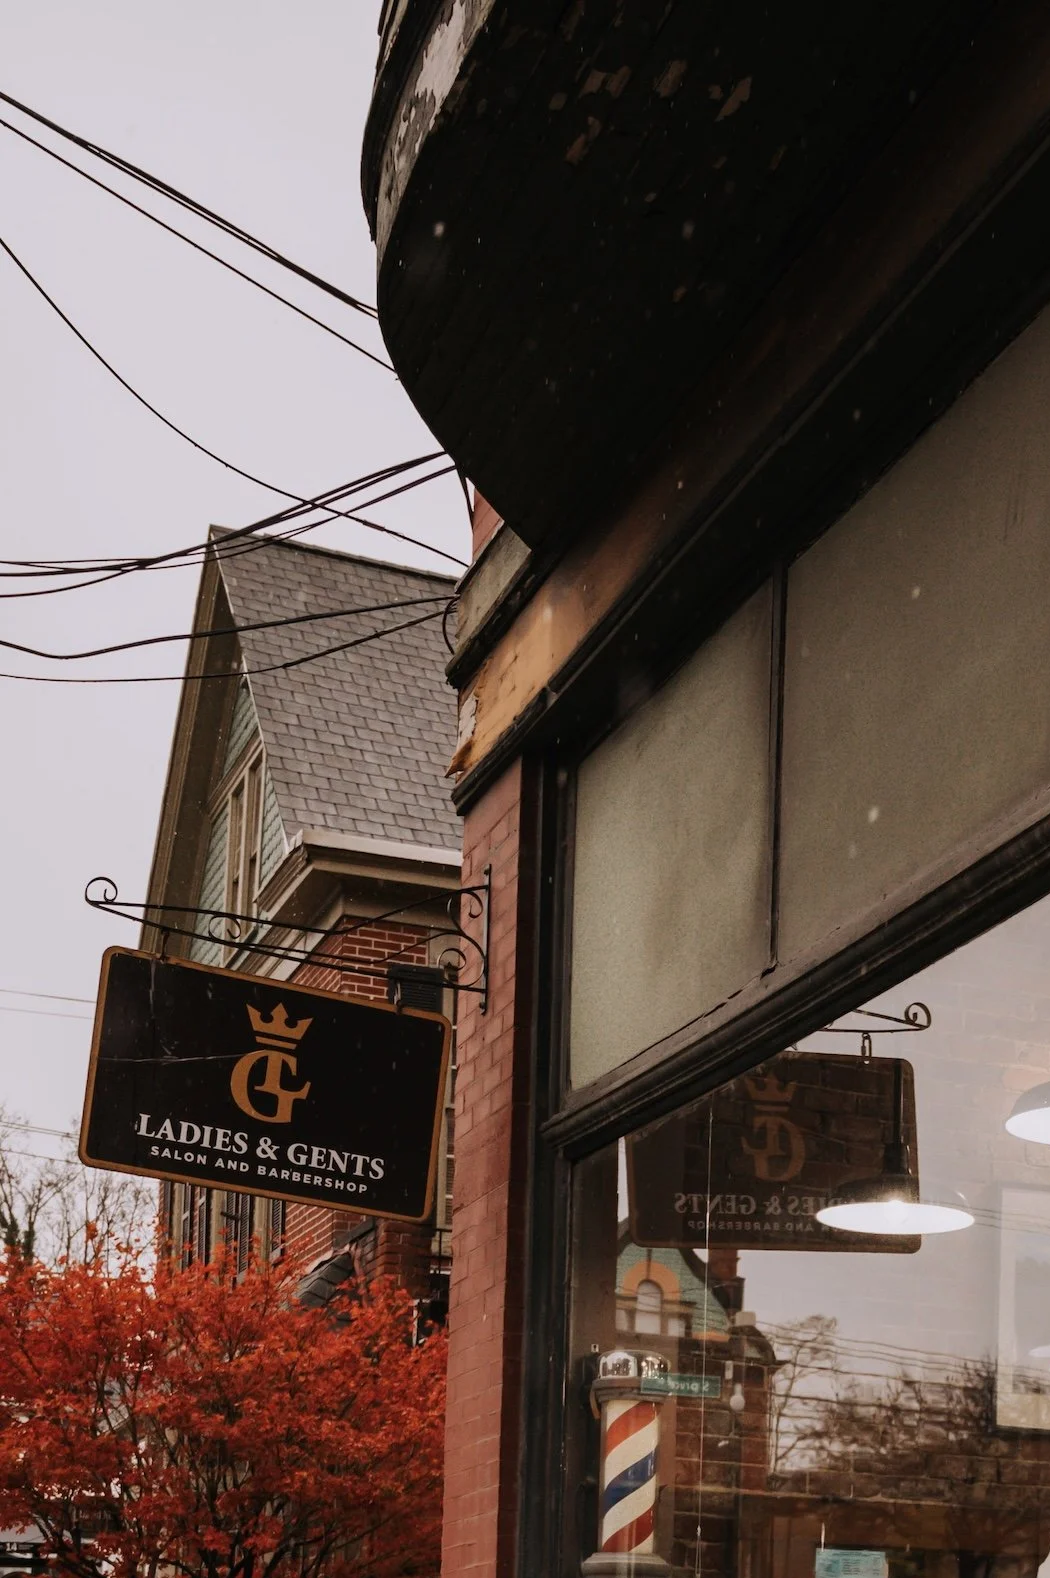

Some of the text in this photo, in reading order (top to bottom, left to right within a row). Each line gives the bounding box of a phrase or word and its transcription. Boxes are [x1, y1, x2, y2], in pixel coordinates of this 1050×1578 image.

[136, 1112, 385, 1180] LADIES & GENTS
[150, 1145, 368, 1193] SALON AND BARBERSHOP
[6, 1542, 18, 1552] 14
